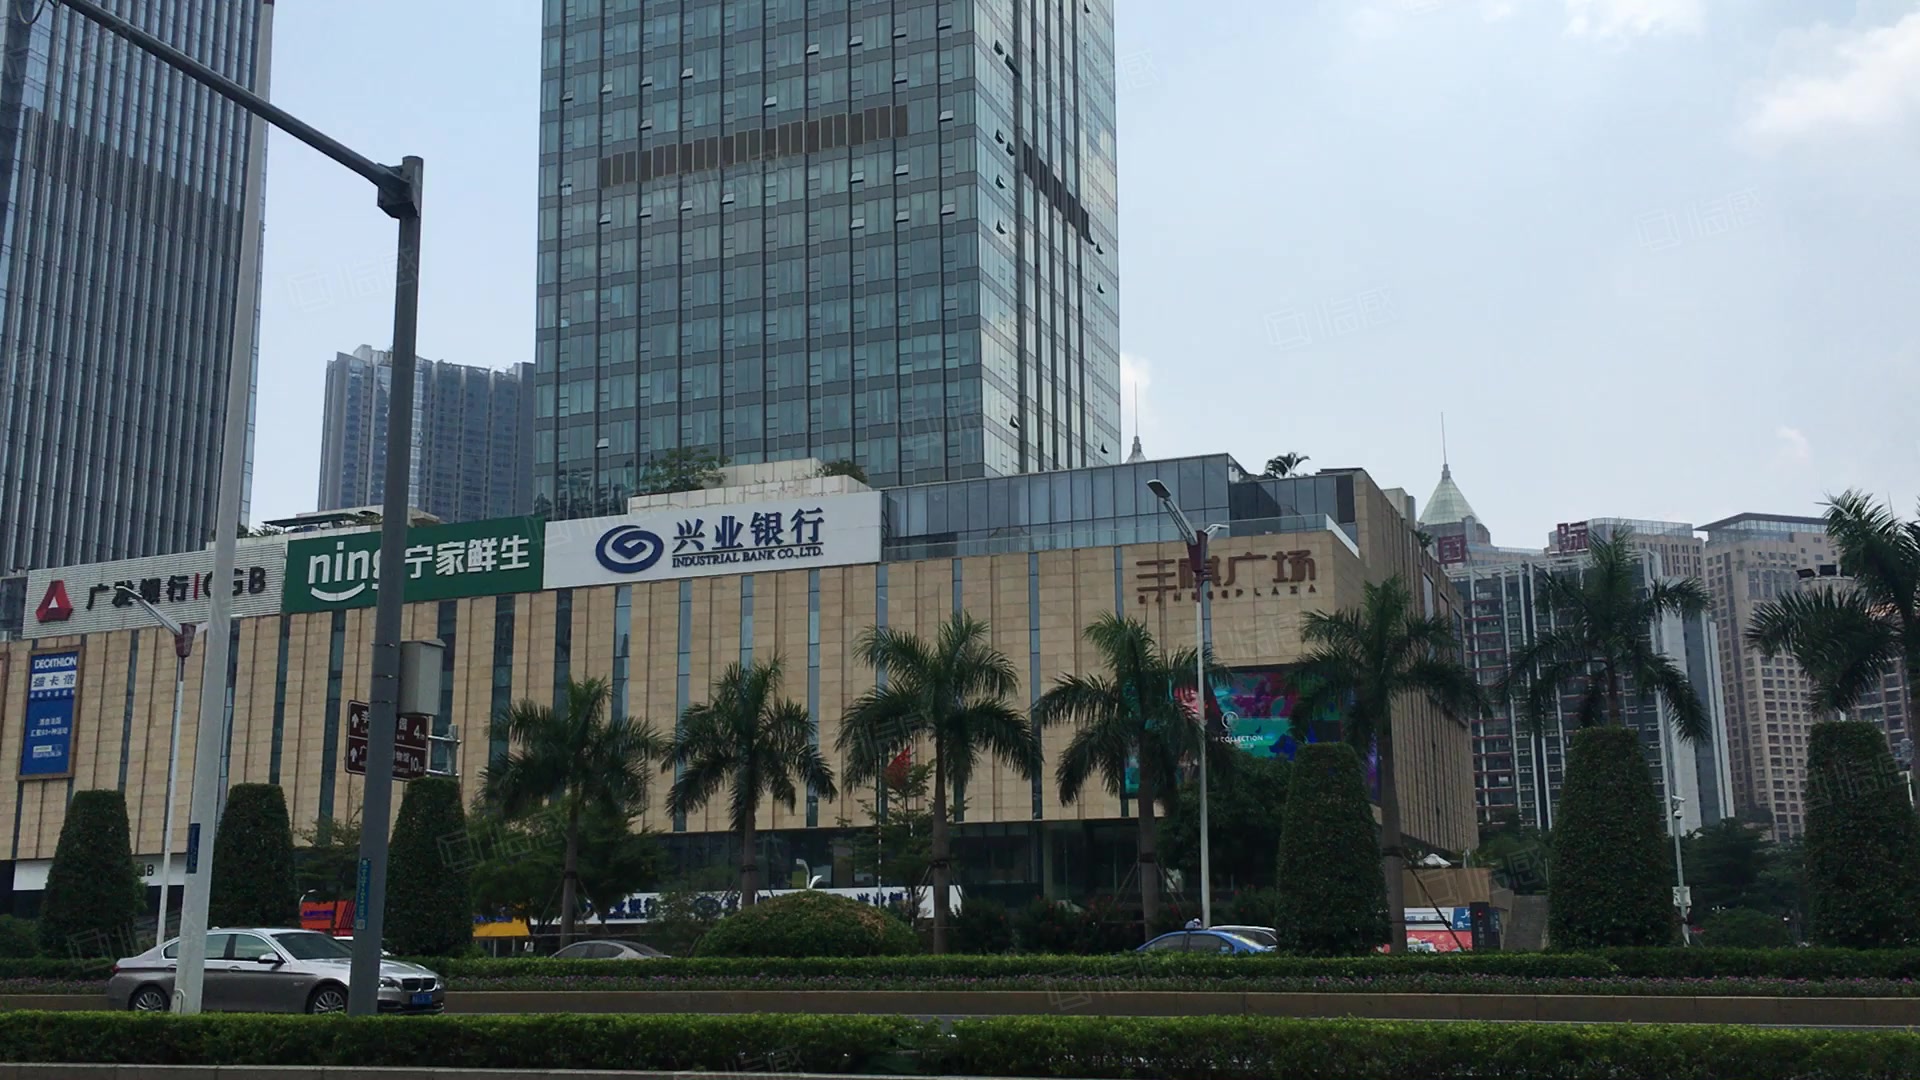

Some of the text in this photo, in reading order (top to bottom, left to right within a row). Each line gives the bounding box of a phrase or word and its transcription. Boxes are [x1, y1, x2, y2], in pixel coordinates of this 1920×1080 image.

[672, 507, 825, 553] 兴业银行
[672, 551, 740, 568] INDUSTRIAL
[742, 549, 776, 563] BANK
[86, 575, 189, 610] 广发银行
